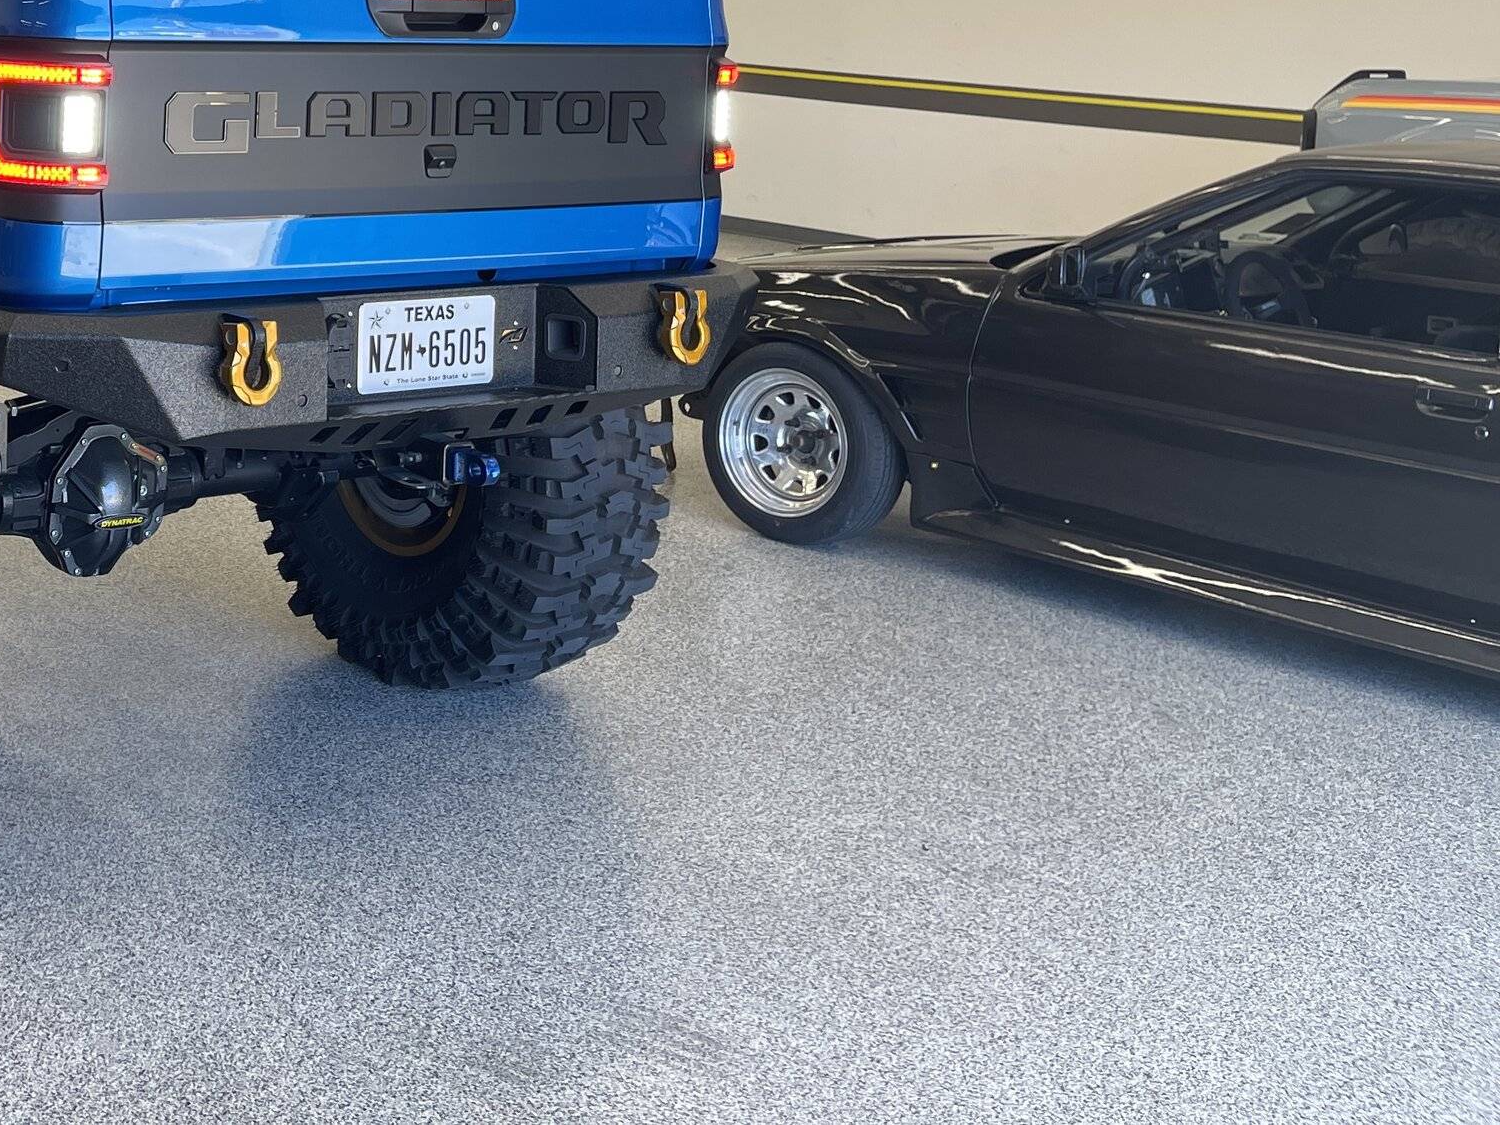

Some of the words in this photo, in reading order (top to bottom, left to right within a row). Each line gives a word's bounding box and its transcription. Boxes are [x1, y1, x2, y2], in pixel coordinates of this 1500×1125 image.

[164, 90, 668, 155] GLADIATOR
[405, 304, 455, 323] TEXAS
[369, 331, 413, 374] NZM
[428, 326, 487, 369] 6505
[101, 516, 144, 528] DYNATRAC
